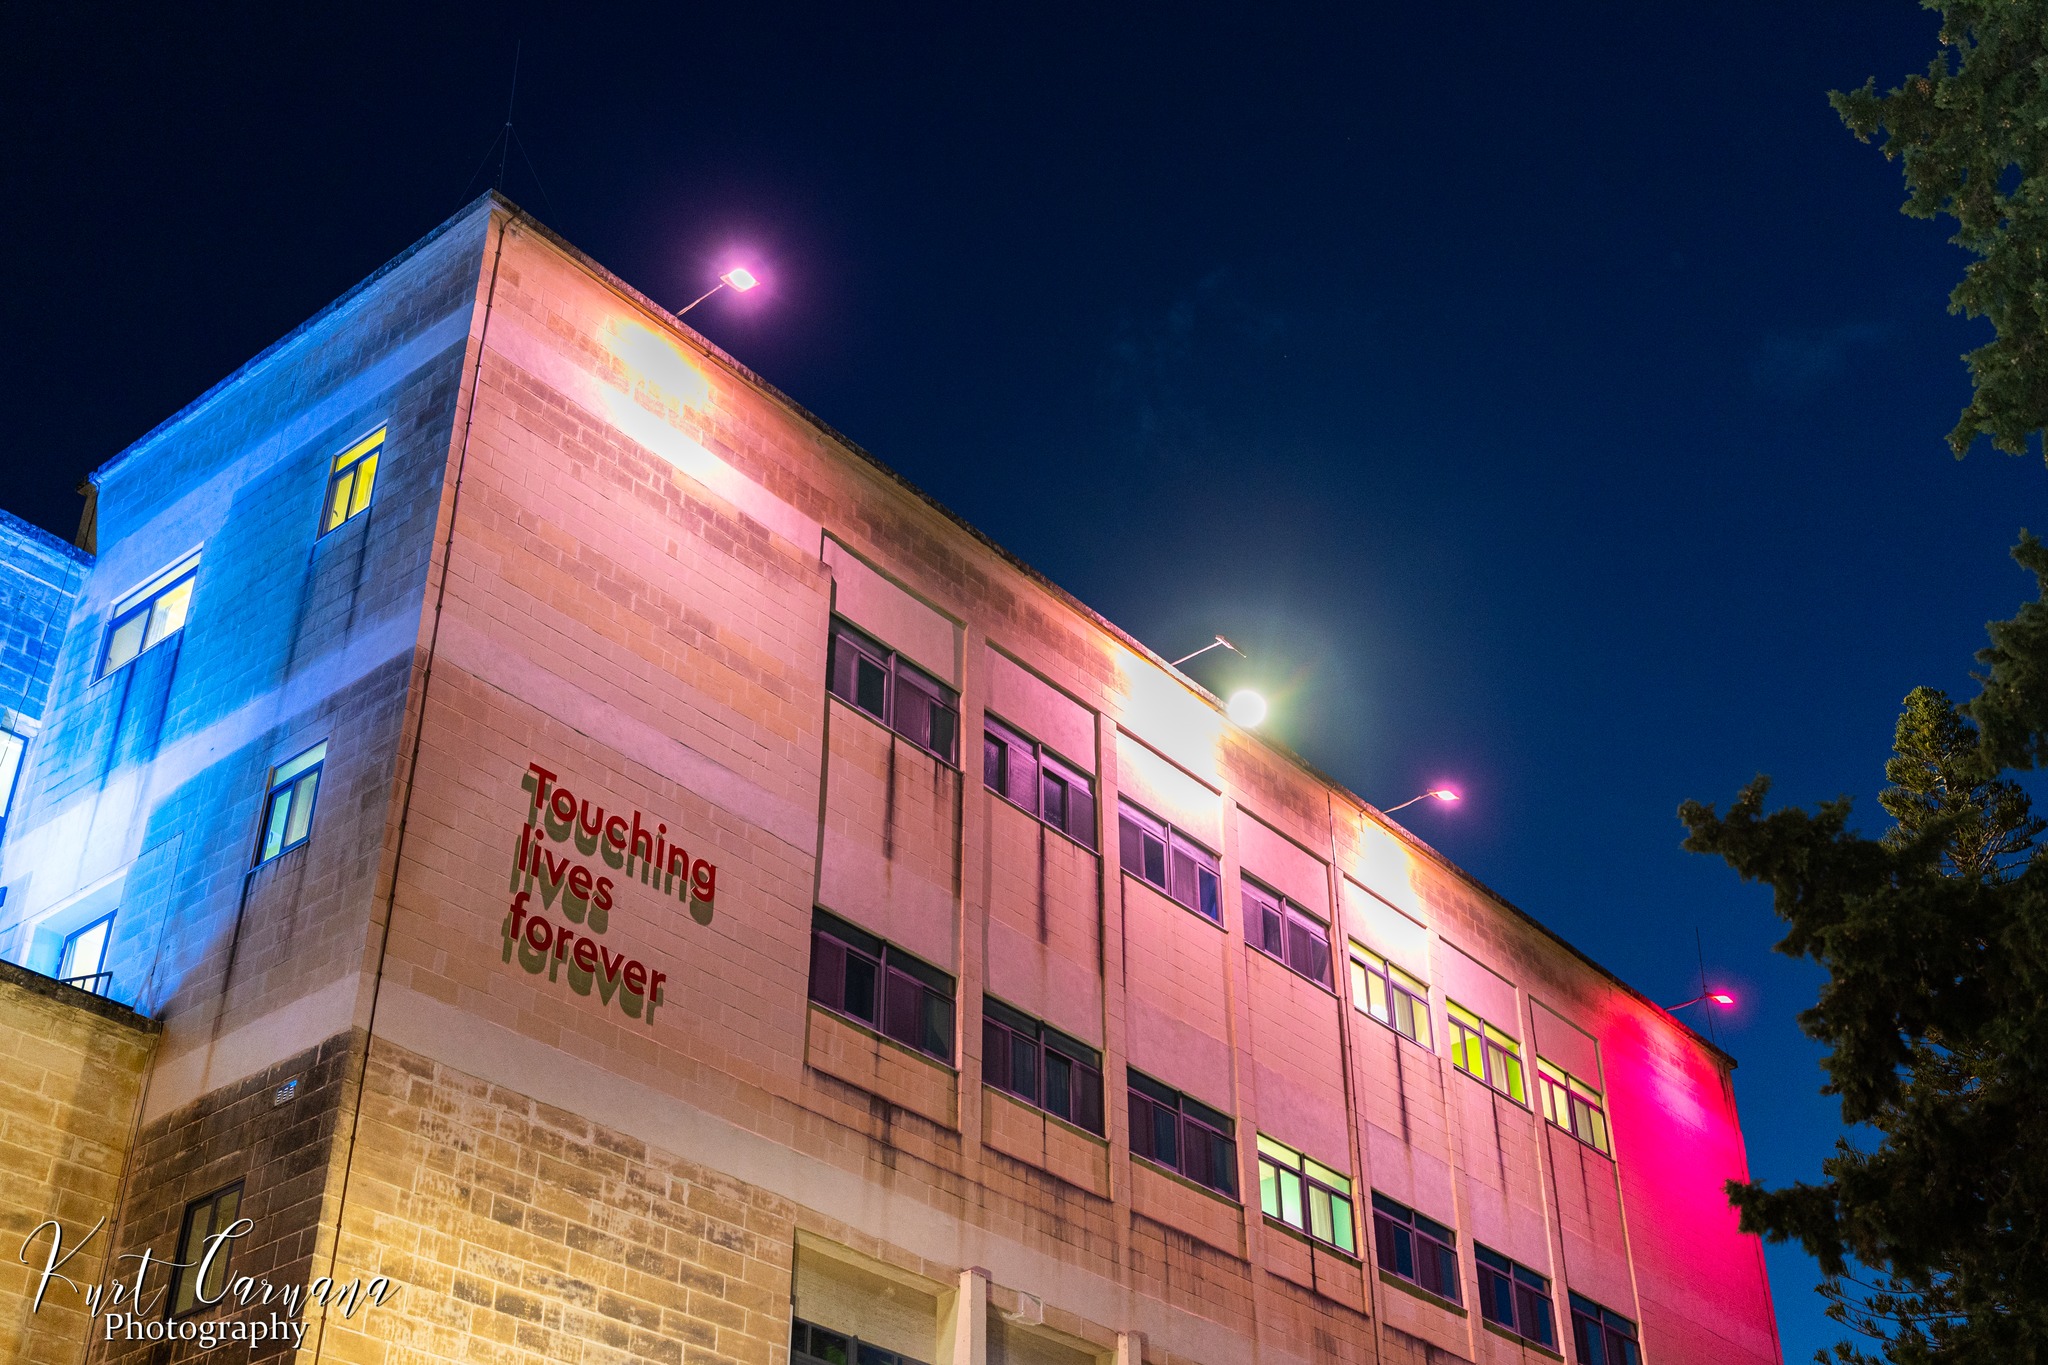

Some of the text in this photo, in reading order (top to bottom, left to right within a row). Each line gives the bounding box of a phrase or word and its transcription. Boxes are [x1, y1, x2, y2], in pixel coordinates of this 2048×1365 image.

[518, 822, 614, 911] lives
[529, 762, 716, 902] Touching
[509, 891, 667, 1002] forever
